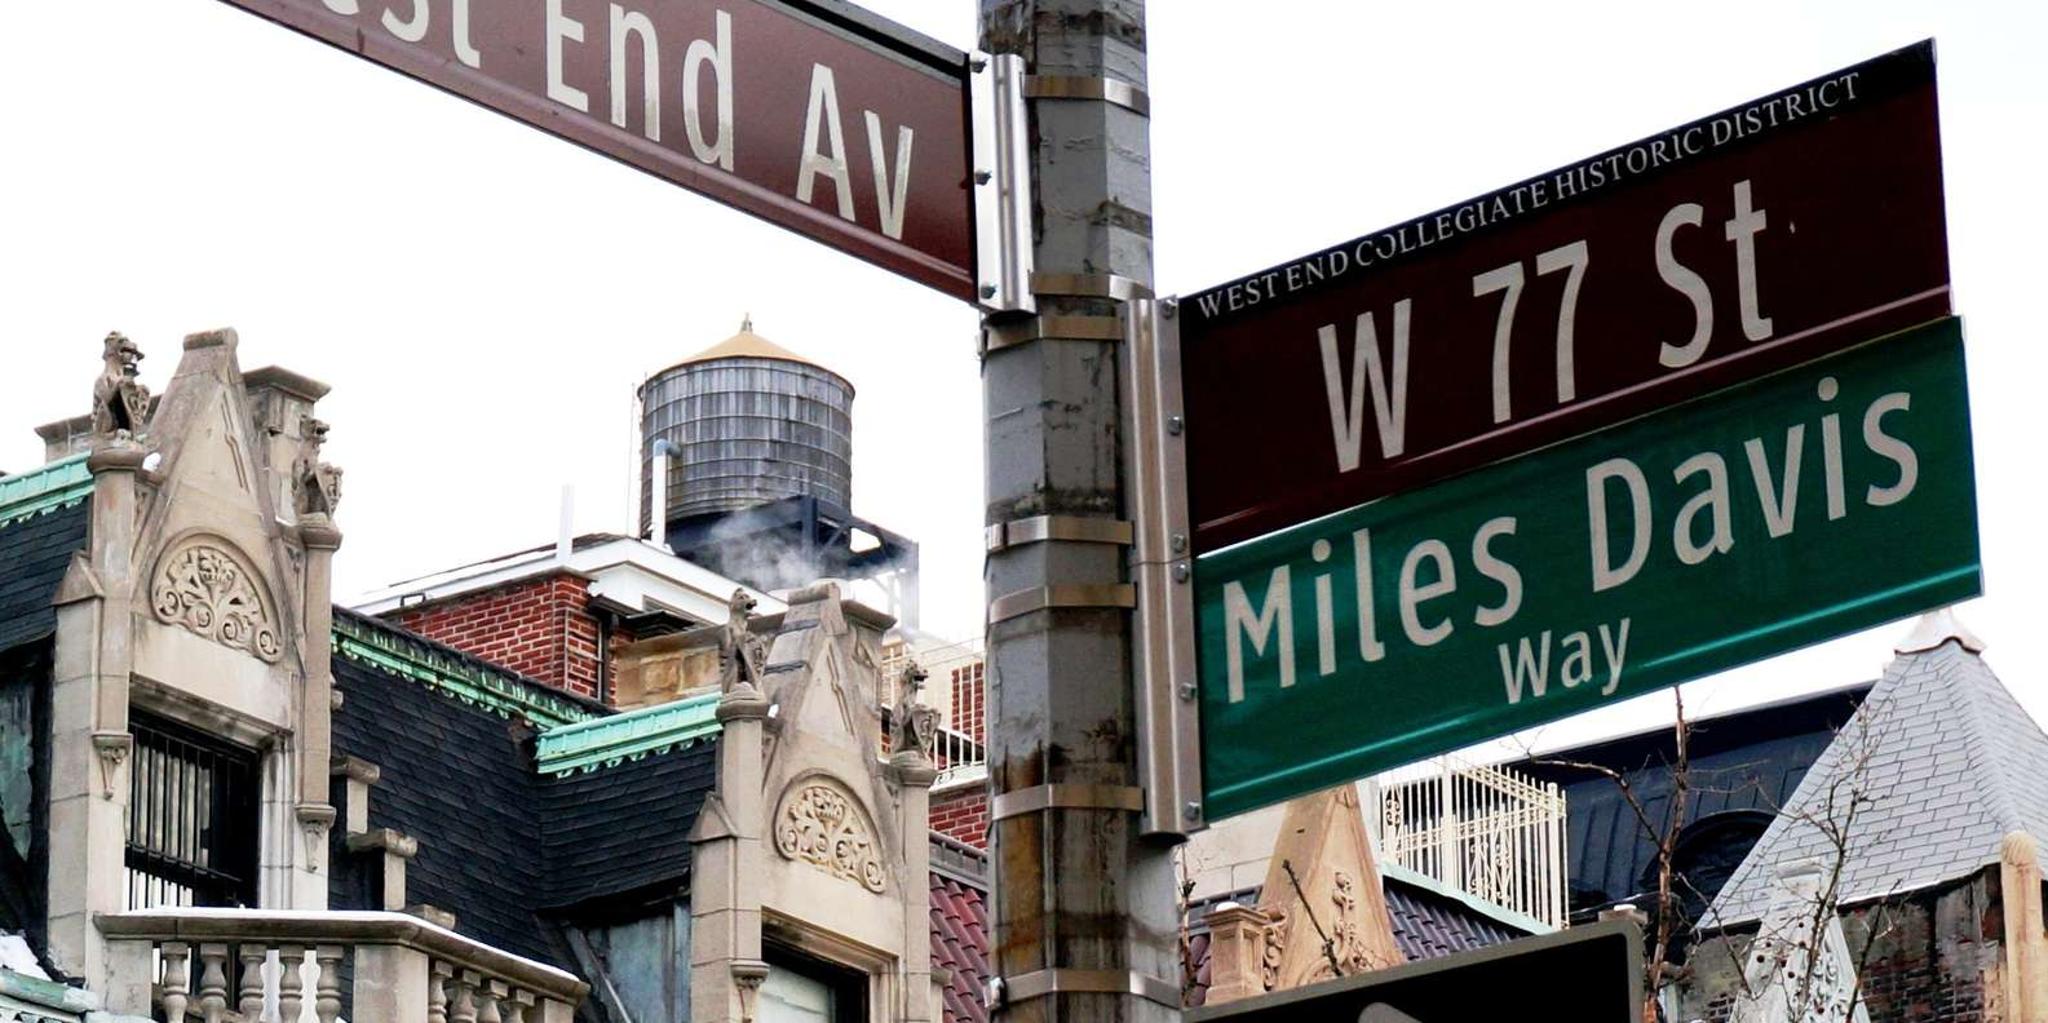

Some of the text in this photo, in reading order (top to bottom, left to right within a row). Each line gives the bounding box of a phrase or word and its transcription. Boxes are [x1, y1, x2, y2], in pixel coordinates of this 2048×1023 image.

[546, 0, 914, 240] End Av
[1197, 72, 1859, 319] WEST END COLLEGIATE HISTORIC DISTRICT
[1318, 179, 1774, 473] W 77 St
[1223, 376, 1919, 703] Miles Davis
[1499, 617, 1631, 704] Way
